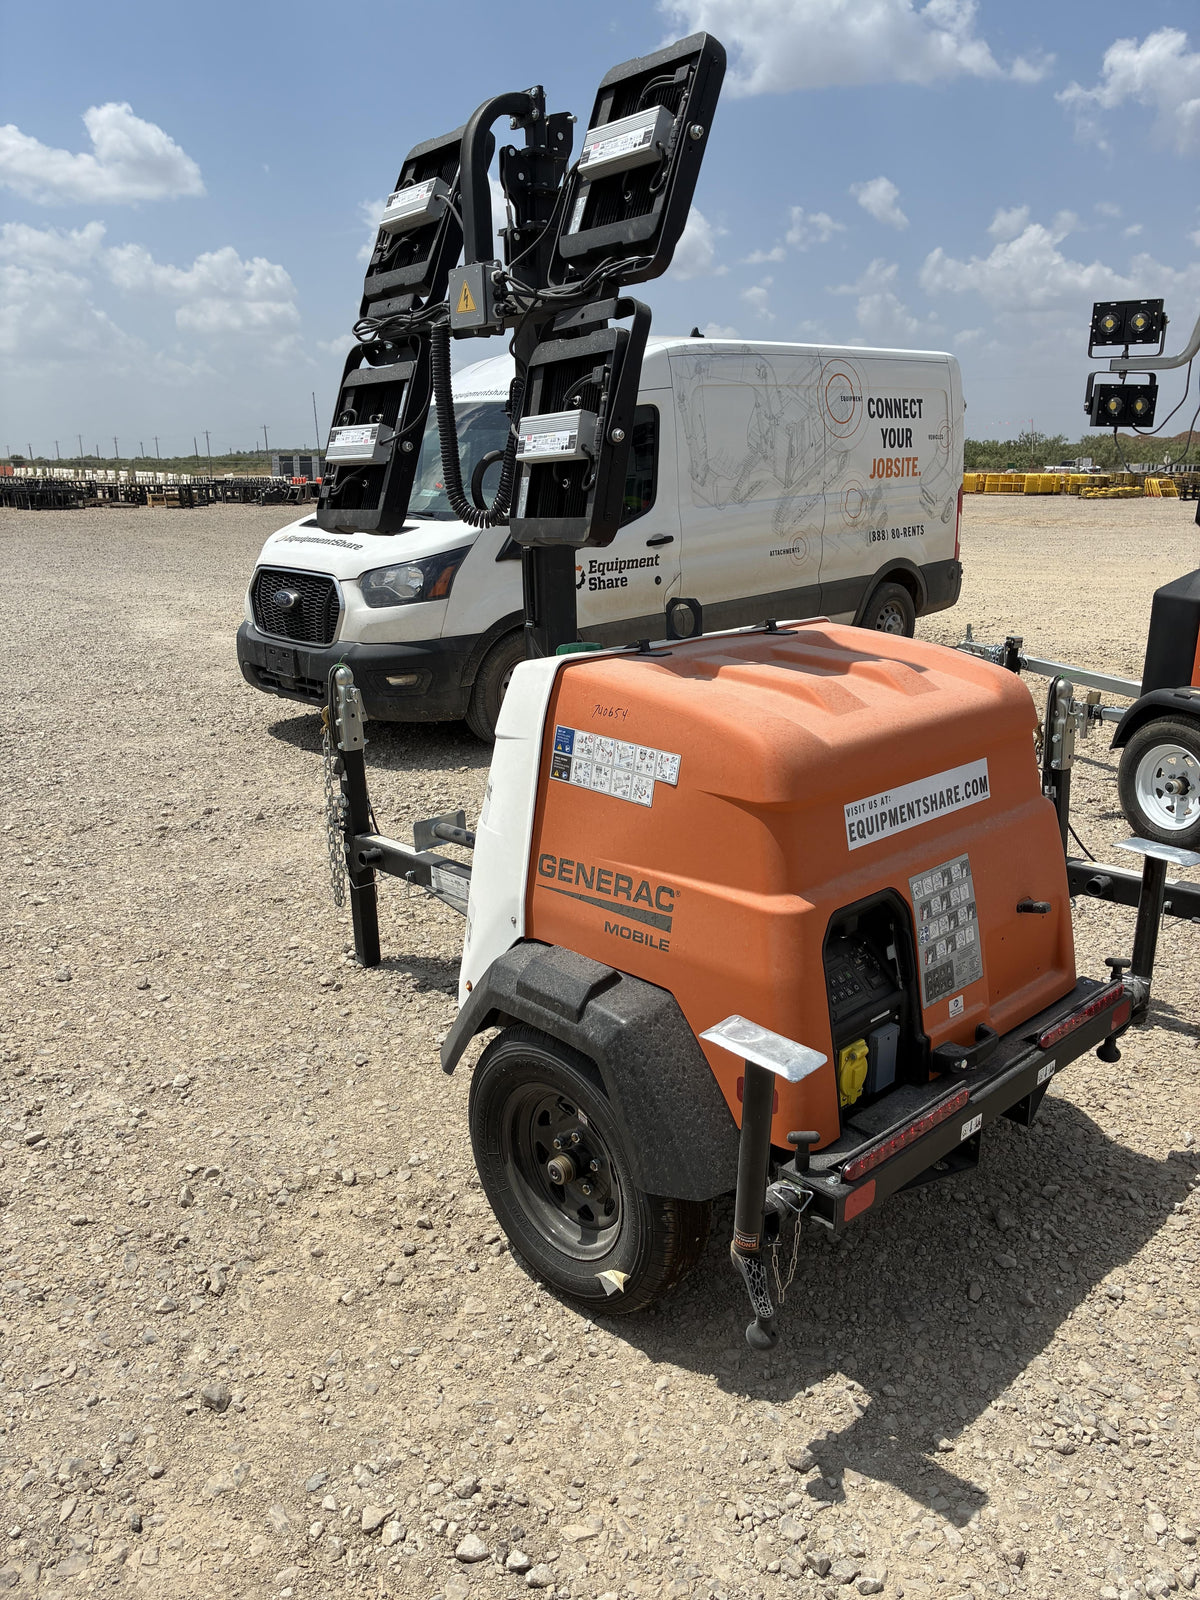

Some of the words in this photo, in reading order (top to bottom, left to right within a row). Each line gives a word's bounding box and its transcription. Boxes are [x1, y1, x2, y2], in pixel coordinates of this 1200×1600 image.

[867, 397, 923, 419] CONNECT
[880, 427, 913, 449] YOUR
[869, 456, 922, 480] JOBSITE.
[286, 535, 364, 550] EquipmentShare
[869, 529, 889, 543] (888)
[891, 524, 925, 539] 80-RENTS
[769, 546, 800, 557] ATTACHMENTS
[588, 554, 660, 576] Equipment
[588, 576, 628, 592] Share
[591, 703, 629, 722] 740654
[845, 803, 866, 818] VISIT
[868, 799, 878, 810] US
[880, 795, 892, 807] AT:
[848, 774, 989, 843] EQUIPMENTSHARE.COM
[538, 853, 675, 913] GENERAC
[604, 920, 670, 953] MOBILE
